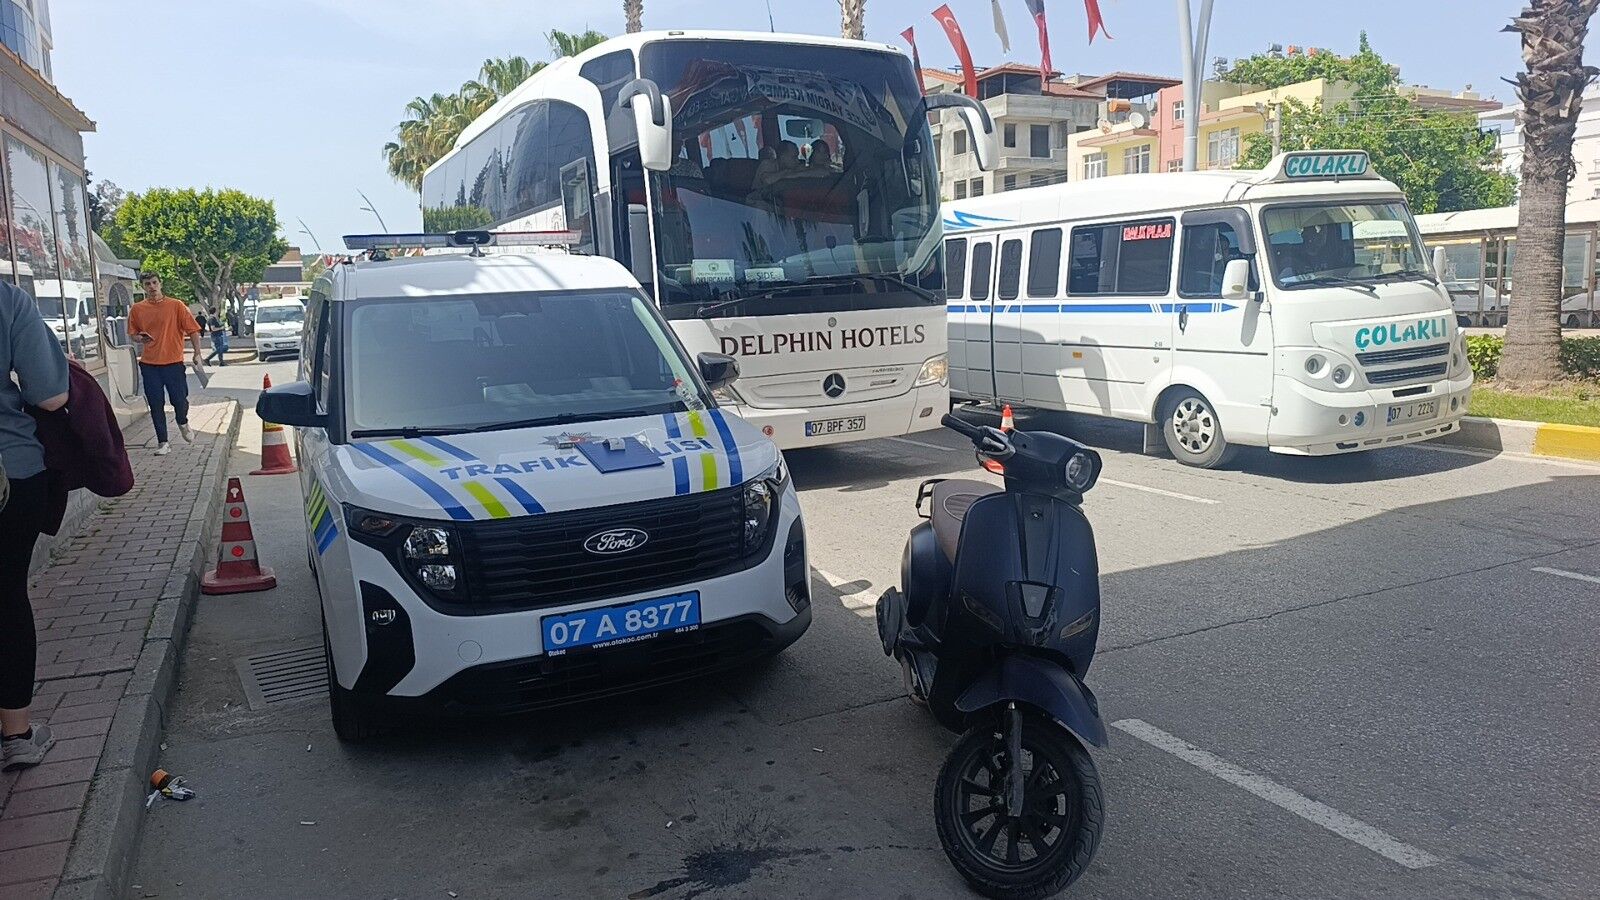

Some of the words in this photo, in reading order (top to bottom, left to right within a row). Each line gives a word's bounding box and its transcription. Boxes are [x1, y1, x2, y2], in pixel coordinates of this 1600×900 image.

[720, 330, 832, 357] DELPHIN
[841, 324, 925, 350] HOTELS
[1355, 318, 1446, 351] ÇOLAKLI
[1391, 407, 1401, 420] 07
[1407, 405, 1413, 417] J
[811, 422, 823, 434] 07
[827, 420, 843, 432] BPF
[847, 418, 863, 430] 357
[440, 454, 587, 480] TRAFİK
[651, 437, 714, 457] LİSİ
[597, 531, 636, 550] Ford
[550, 619, 586, 645] 07
[596, 614, 618, 638] A
[625, 599, 692, 632] 8377
[592, 632, 658, 648] www.otokoc.com.tr
